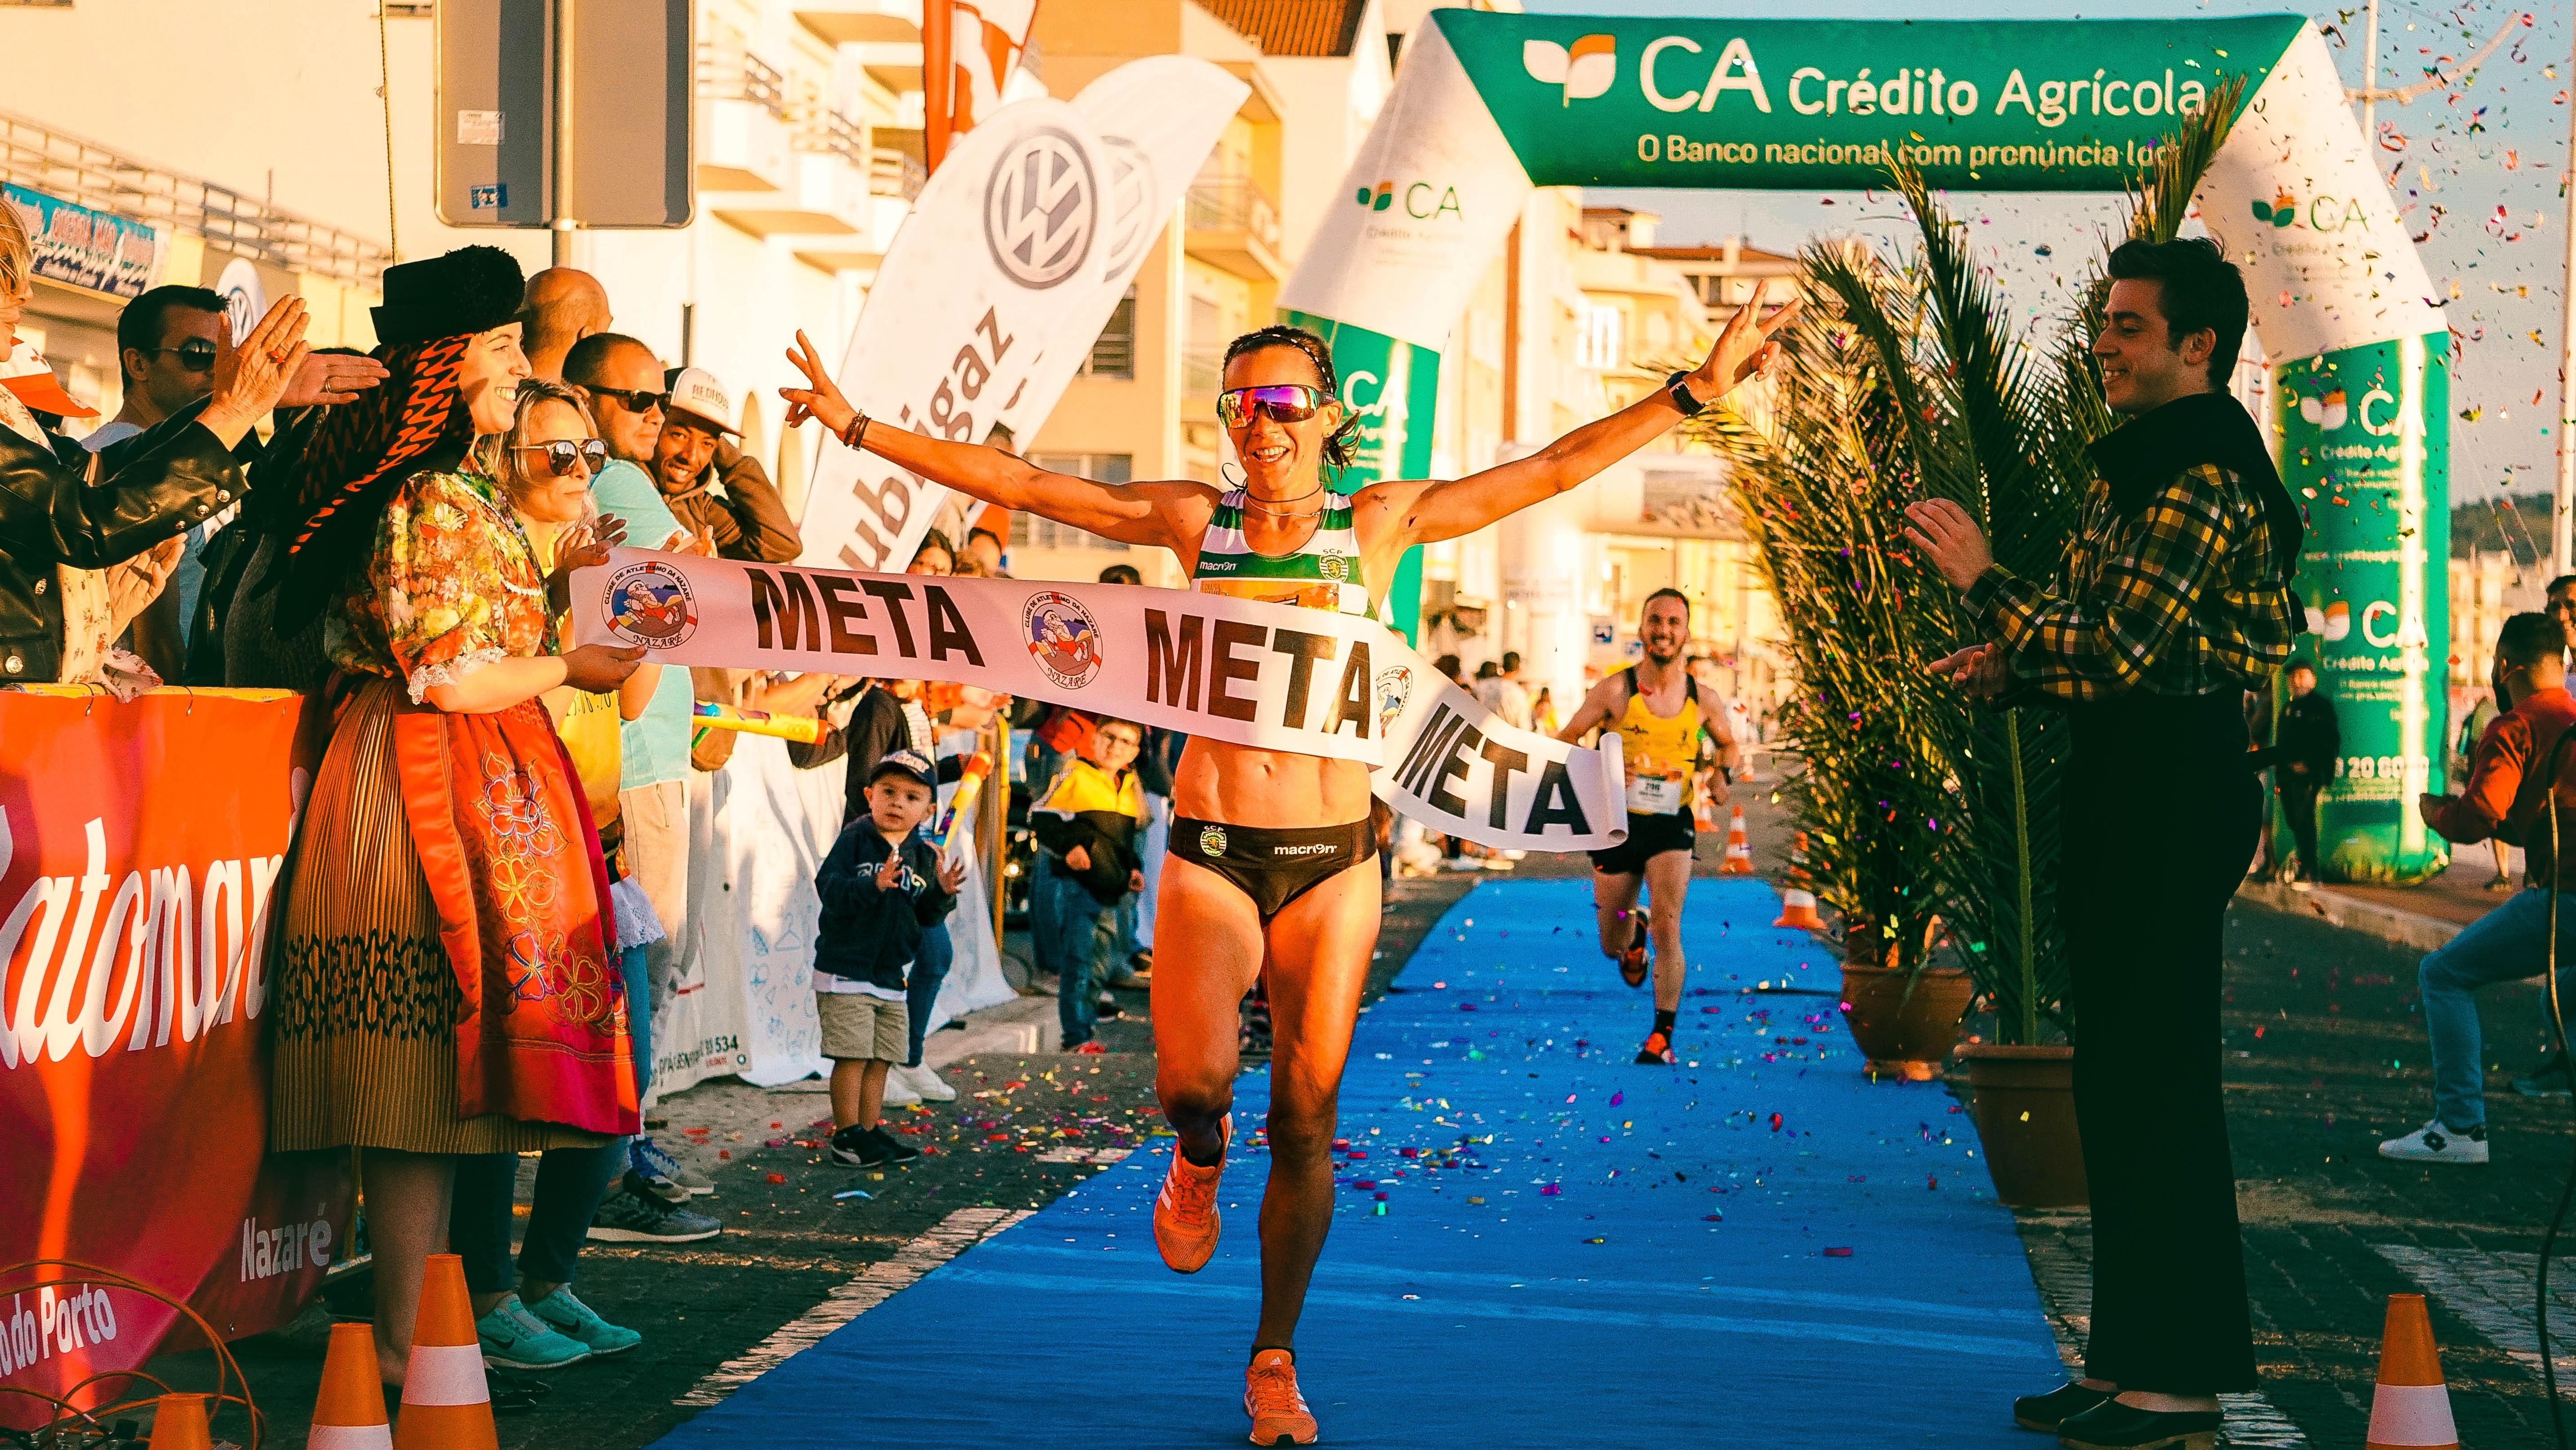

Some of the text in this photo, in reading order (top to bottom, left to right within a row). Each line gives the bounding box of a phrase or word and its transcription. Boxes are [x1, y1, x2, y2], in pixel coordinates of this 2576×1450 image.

[1639, 36, 2205, 127] CA Crédito Agrícola
[1638, 134, 1660, 162] O
[1667, 134, 1758, 162] Banco
[1765, 138, 1888, 166] nacional
[1897, 145, 1961, 166] com
[1969, 138, 2118, 170] pronúncia
[1406, 182, 1462, 221] CA
[2310, 196, 2369, 232] CA
[604, 565, 693, 604] CLUBE DE ATLETISMO DA NAZARÉ
[743, 567, 986, 668] META
[1025, 607, 1033, 628] CLUBE
[1036, 595, 1070, 604] ATLETISMO
[1072, 602, 1080, 611] DA
[1081, 610, 1100, 639] NAZARÉ
[633, 631, 683, 648] NAZARÉ
[1047, 667, 1087, 688] NAZARÉ
[1144, 608, 1371, 740] META
[1392, 702, 1593, 835] META
[241, 1201, 332, 1282] Nazaré
[11, 1293, 37, 1370] do
[40, 1283, 117, 1360] Porto
